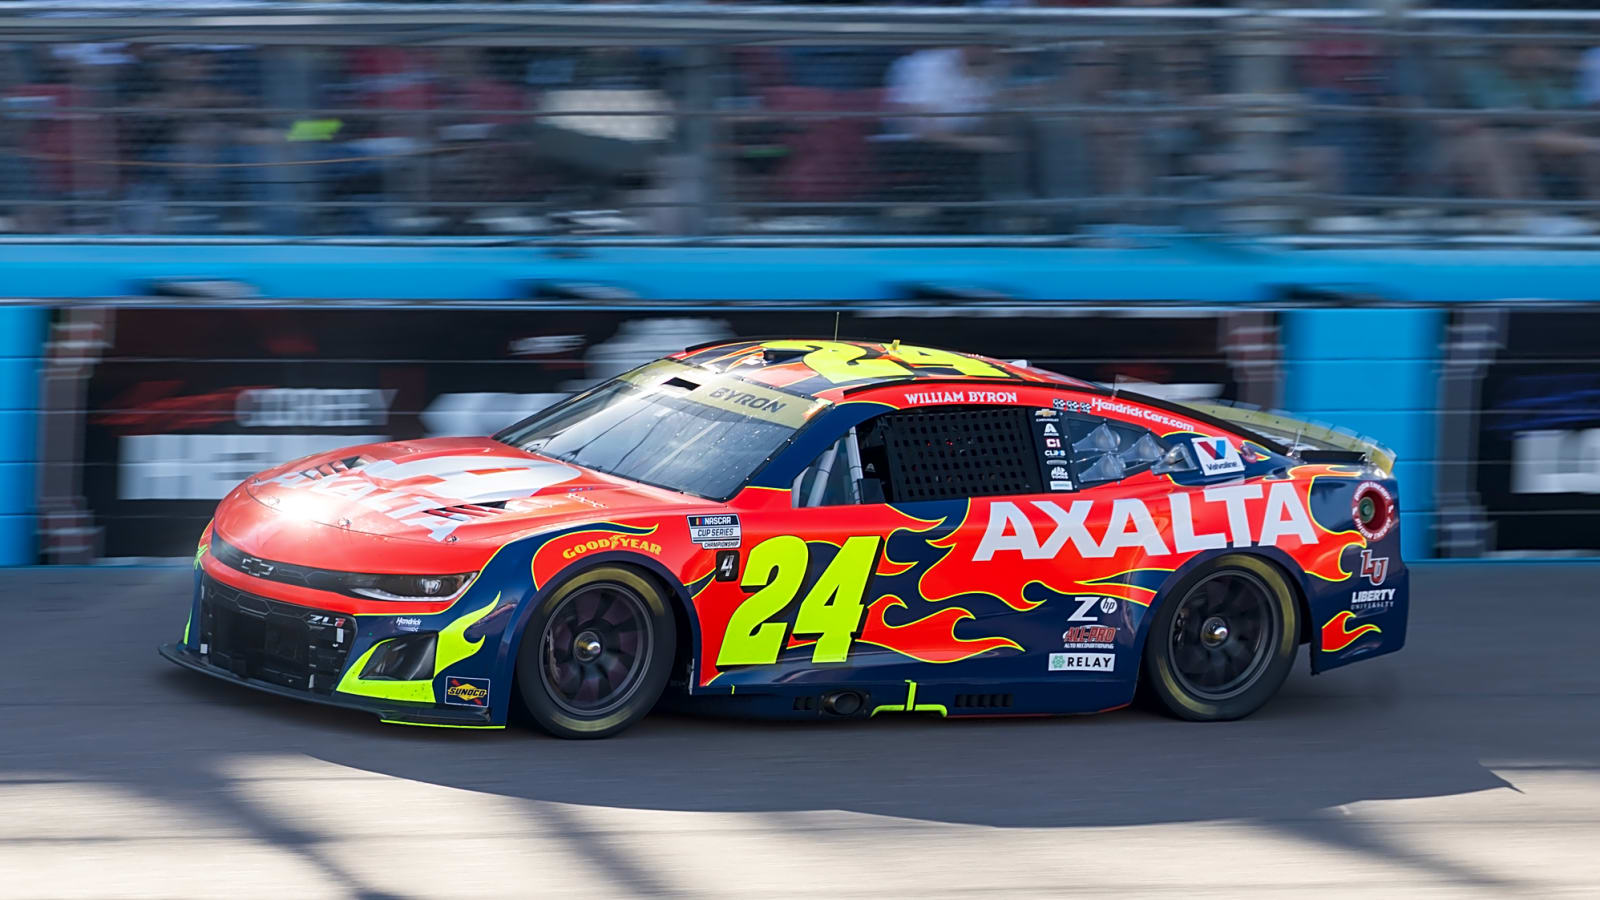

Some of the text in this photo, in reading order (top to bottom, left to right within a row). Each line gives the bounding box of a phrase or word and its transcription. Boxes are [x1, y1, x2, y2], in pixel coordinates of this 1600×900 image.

[710, 387, 787, 413] BYRON
[905, 391, 1017, 404] WILLIAM BYRON
[1206, 461, 1237, 471] Valvoline
[704, 517, 731, 525] NASCAR
[972, 481, 1320, 561] AXALTA
[698, 528, 734, 537] CUP SERIES
[562, 534, 662, 559] GOODYEAR
[720, 555, 735, 577] 4
[1360, 549, 1389, 586] LU
[715, 535, 884, 667] 24
[1352, 588, 1396, 603] LIBERTY
[1067, 597, 1116, 621] Z hp
[1350, 602, 1394, 610] UNIVERSITY
[396, 617, 422, 626] Hendrick
[1063, 626, 1116, 643] ALL-PRO
[1067, 657, 1111, 668] RELAY
[449, 686, 487, 697] SUNOCO
